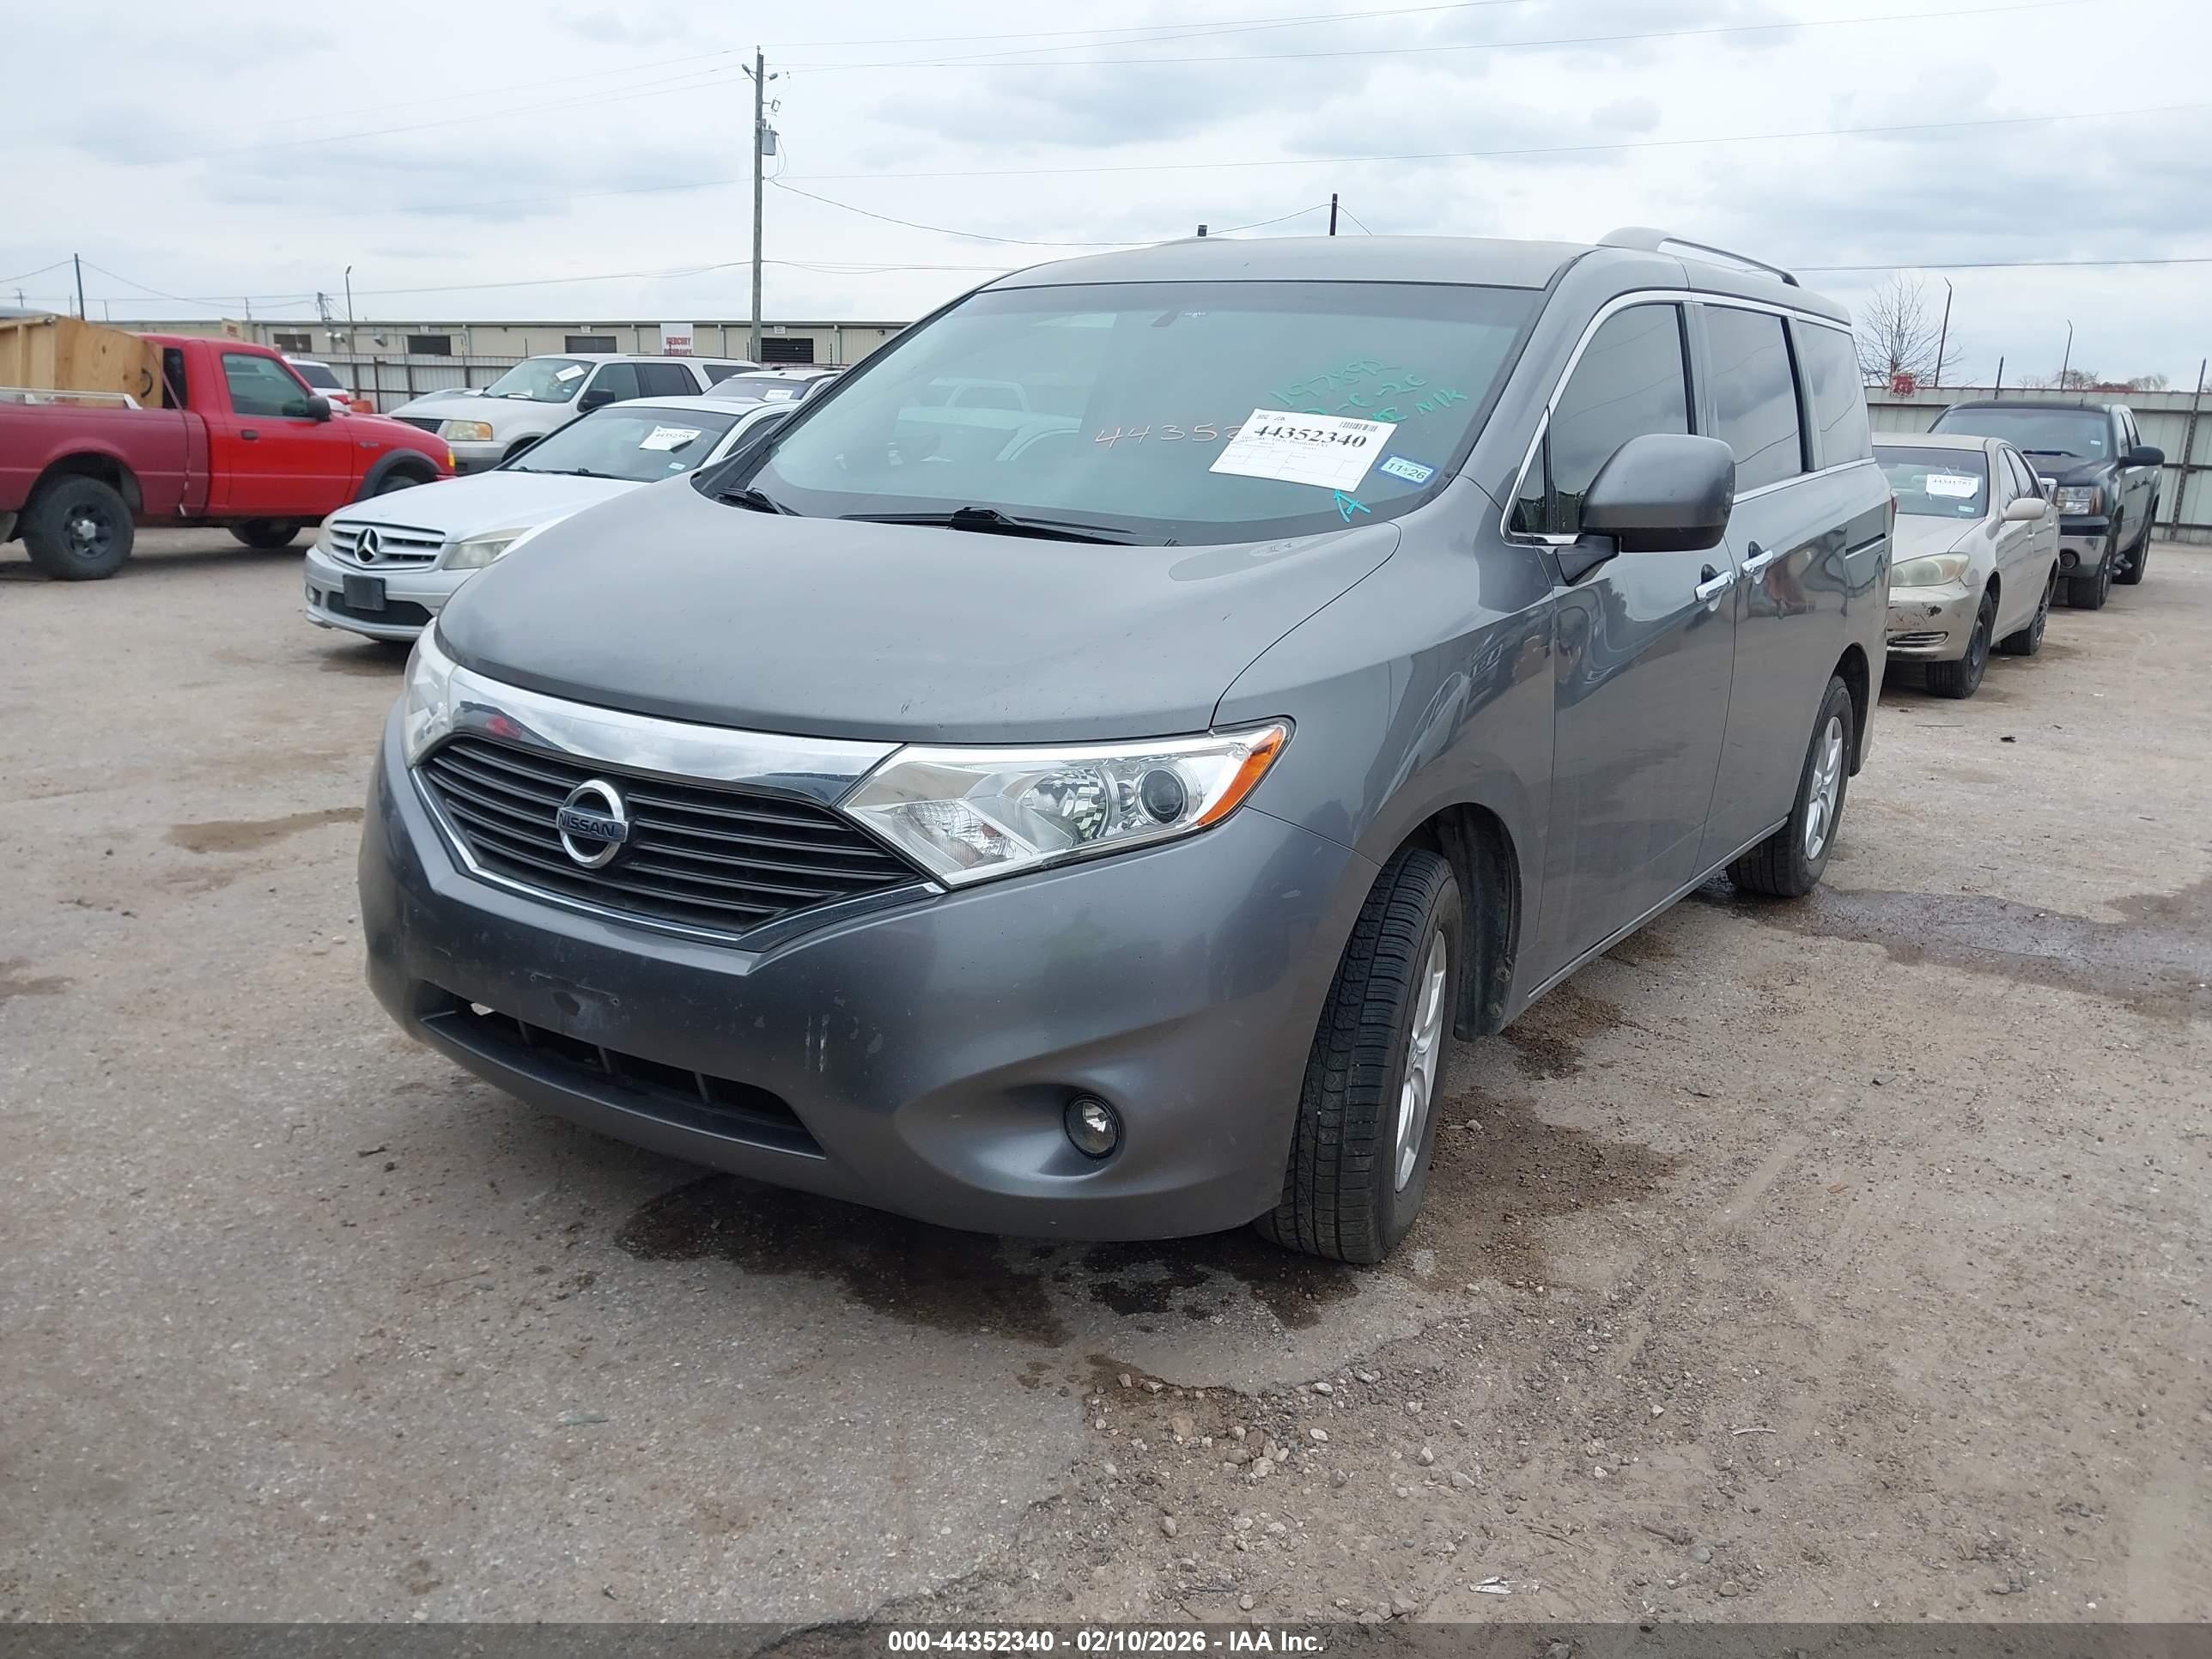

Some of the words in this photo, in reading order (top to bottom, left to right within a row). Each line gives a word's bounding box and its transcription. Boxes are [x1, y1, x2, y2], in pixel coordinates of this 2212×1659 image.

[1255, 426, 1367, 447] 44352340
[1407, 469, 1427, 479] 26
[558, 812, 616, 838] NISSAN
